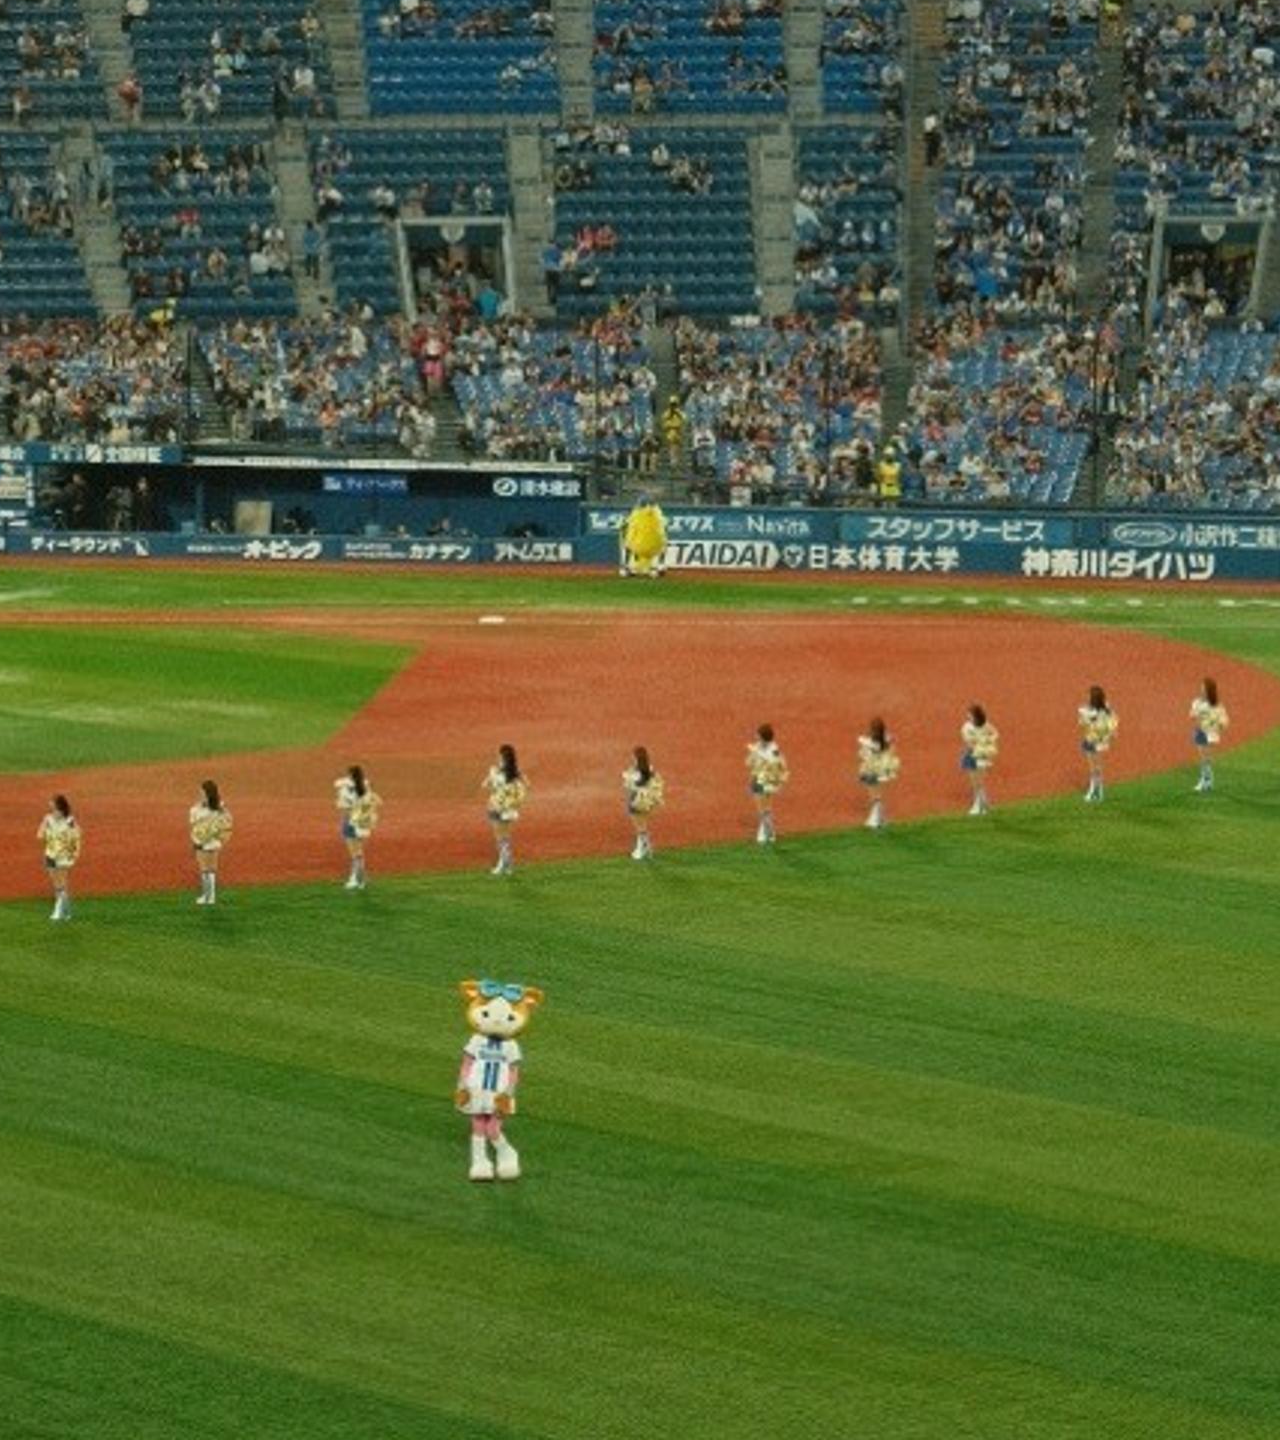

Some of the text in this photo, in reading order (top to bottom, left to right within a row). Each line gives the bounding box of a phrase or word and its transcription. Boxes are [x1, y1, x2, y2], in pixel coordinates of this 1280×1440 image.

[868, 517, 1045, 542] スタッフサービス
[809, 546, 960, 572] 日本体育大学
[1021, 548, 1215, 581] 神奈川ダイハツ
